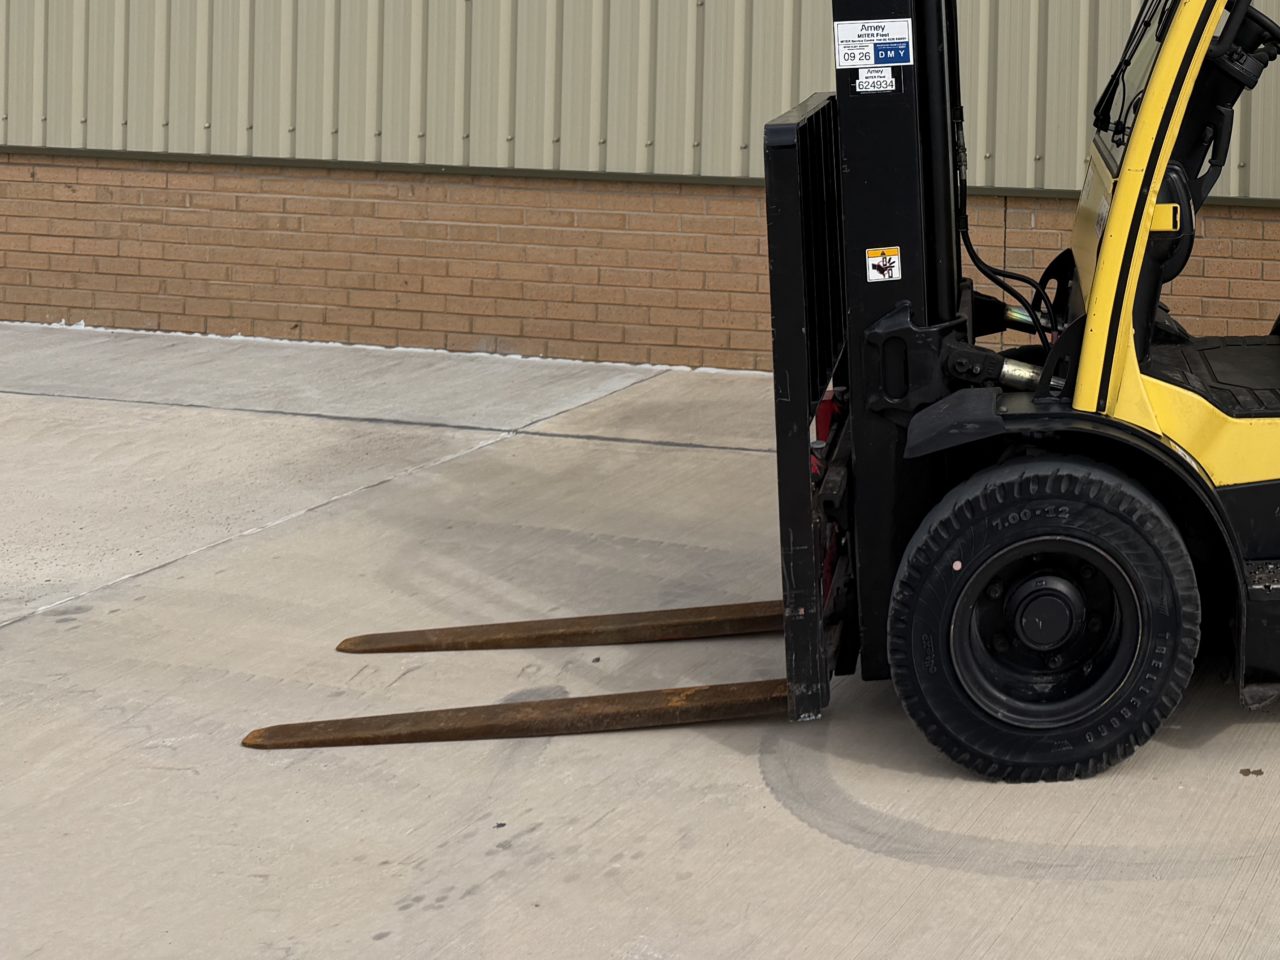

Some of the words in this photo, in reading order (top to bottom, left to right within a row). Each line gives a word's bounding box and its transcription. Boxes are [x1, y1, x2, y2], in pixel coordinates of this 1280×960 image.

[860, 24, 886, 33] Amey
[843, 52, 856, 62] 09
[858, 52, 871, 61] 26
[887, 50, 895, 58] M
[858, 80, 894, 90] 624934
